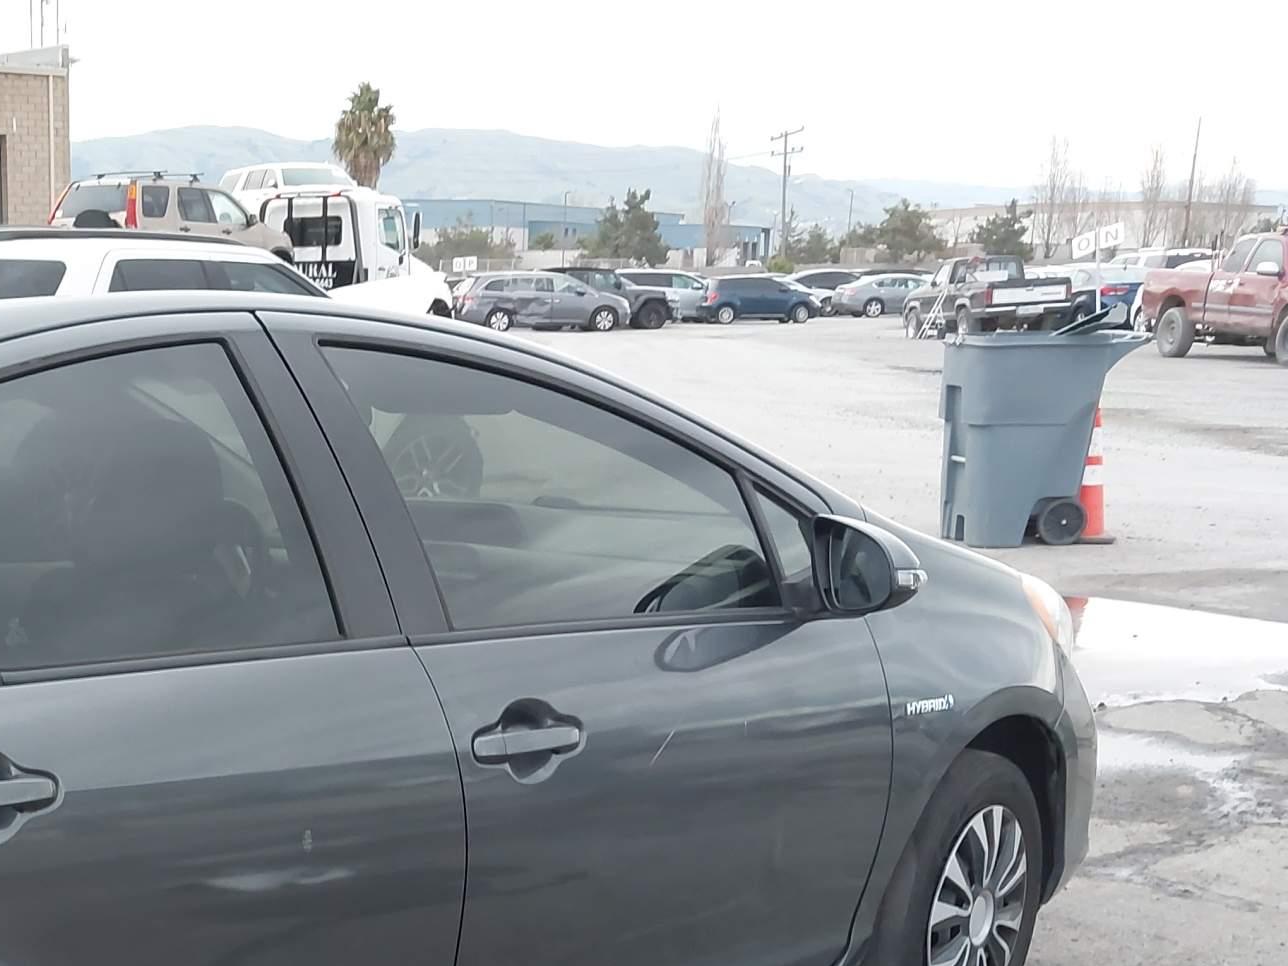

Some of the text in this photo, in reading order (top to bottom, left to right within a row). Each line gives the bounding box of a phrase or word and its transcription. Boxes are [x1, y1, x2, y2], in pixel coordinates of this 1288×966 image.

[1105, 227, 1119, 243] N
[295, 262, 337, 278] URAL
[906, 697, 948, 715] HYBRID
